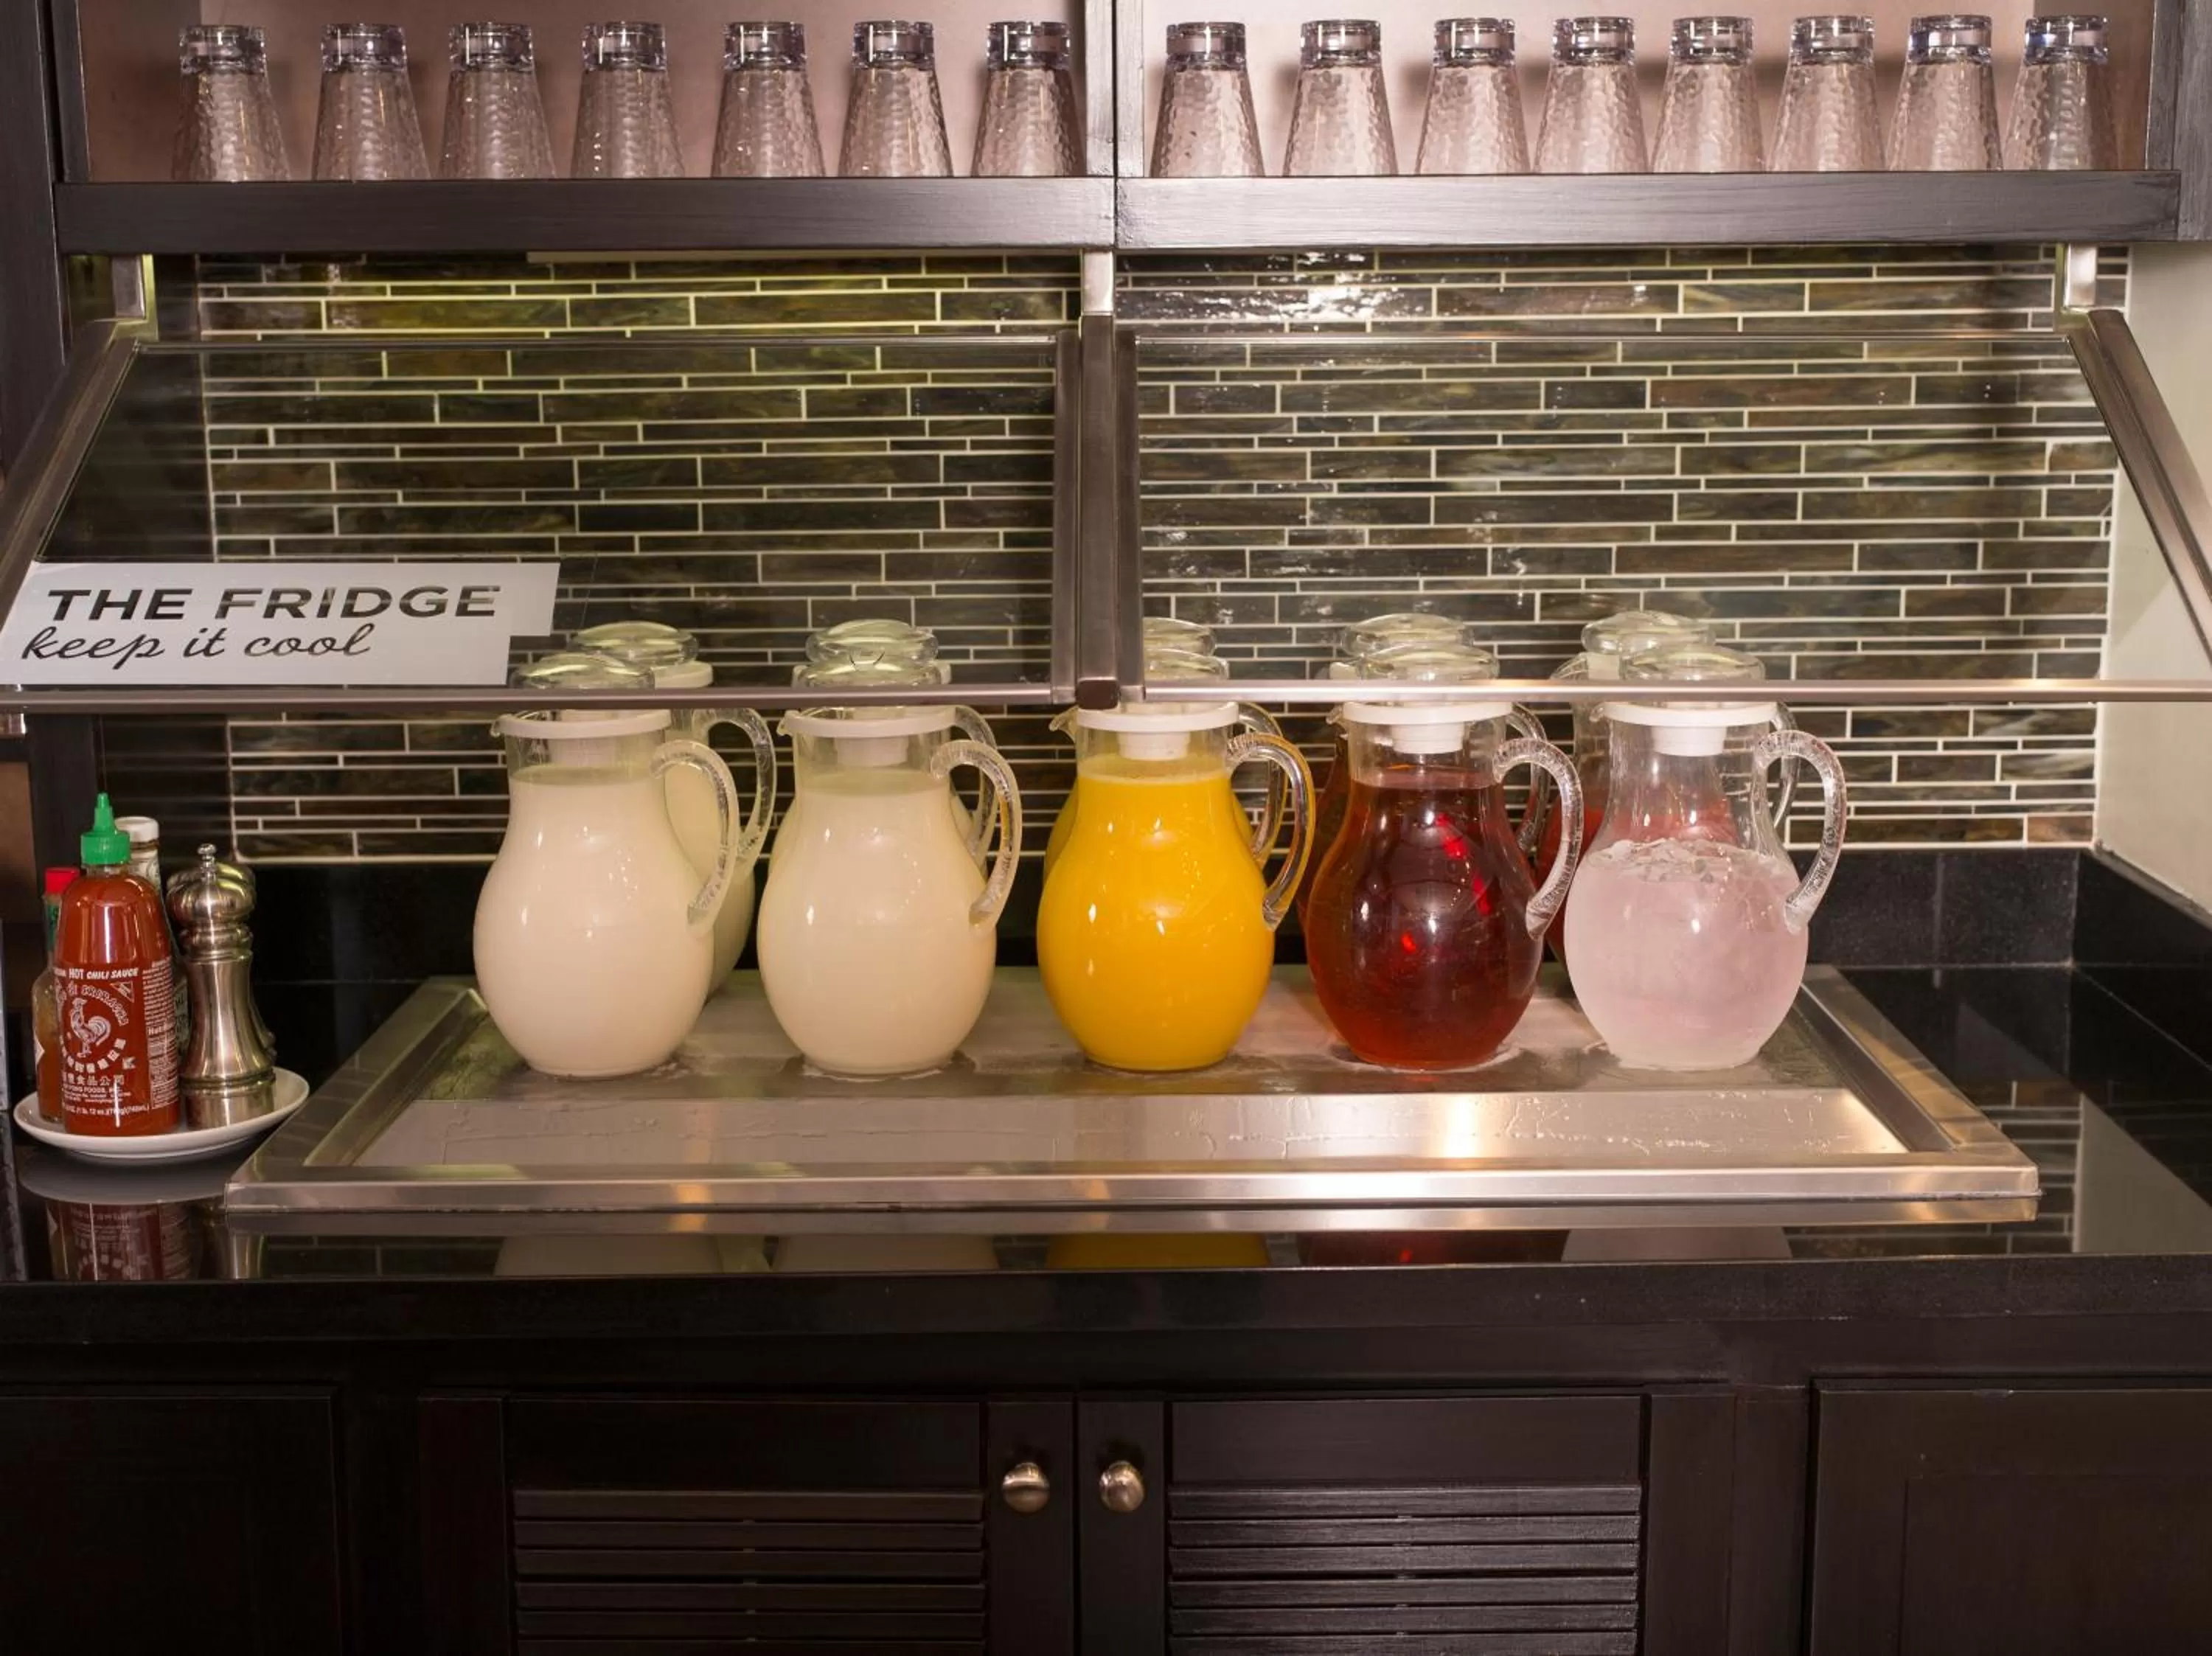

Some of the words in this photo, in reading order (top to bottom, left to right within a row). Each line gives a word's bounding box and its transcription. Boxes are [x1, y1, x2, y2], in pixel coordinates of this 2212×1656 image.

[48, 588, 193, 621] THE
[215, 585, 501, 619] FRIDGE
[21, 626, 165, 670] keep
[183, 627, 228, 658] it
[244, 622, 375, 657] cool
[69, 968, 84, 980] HOT
[110, 967, 139, 978] SAUCE
